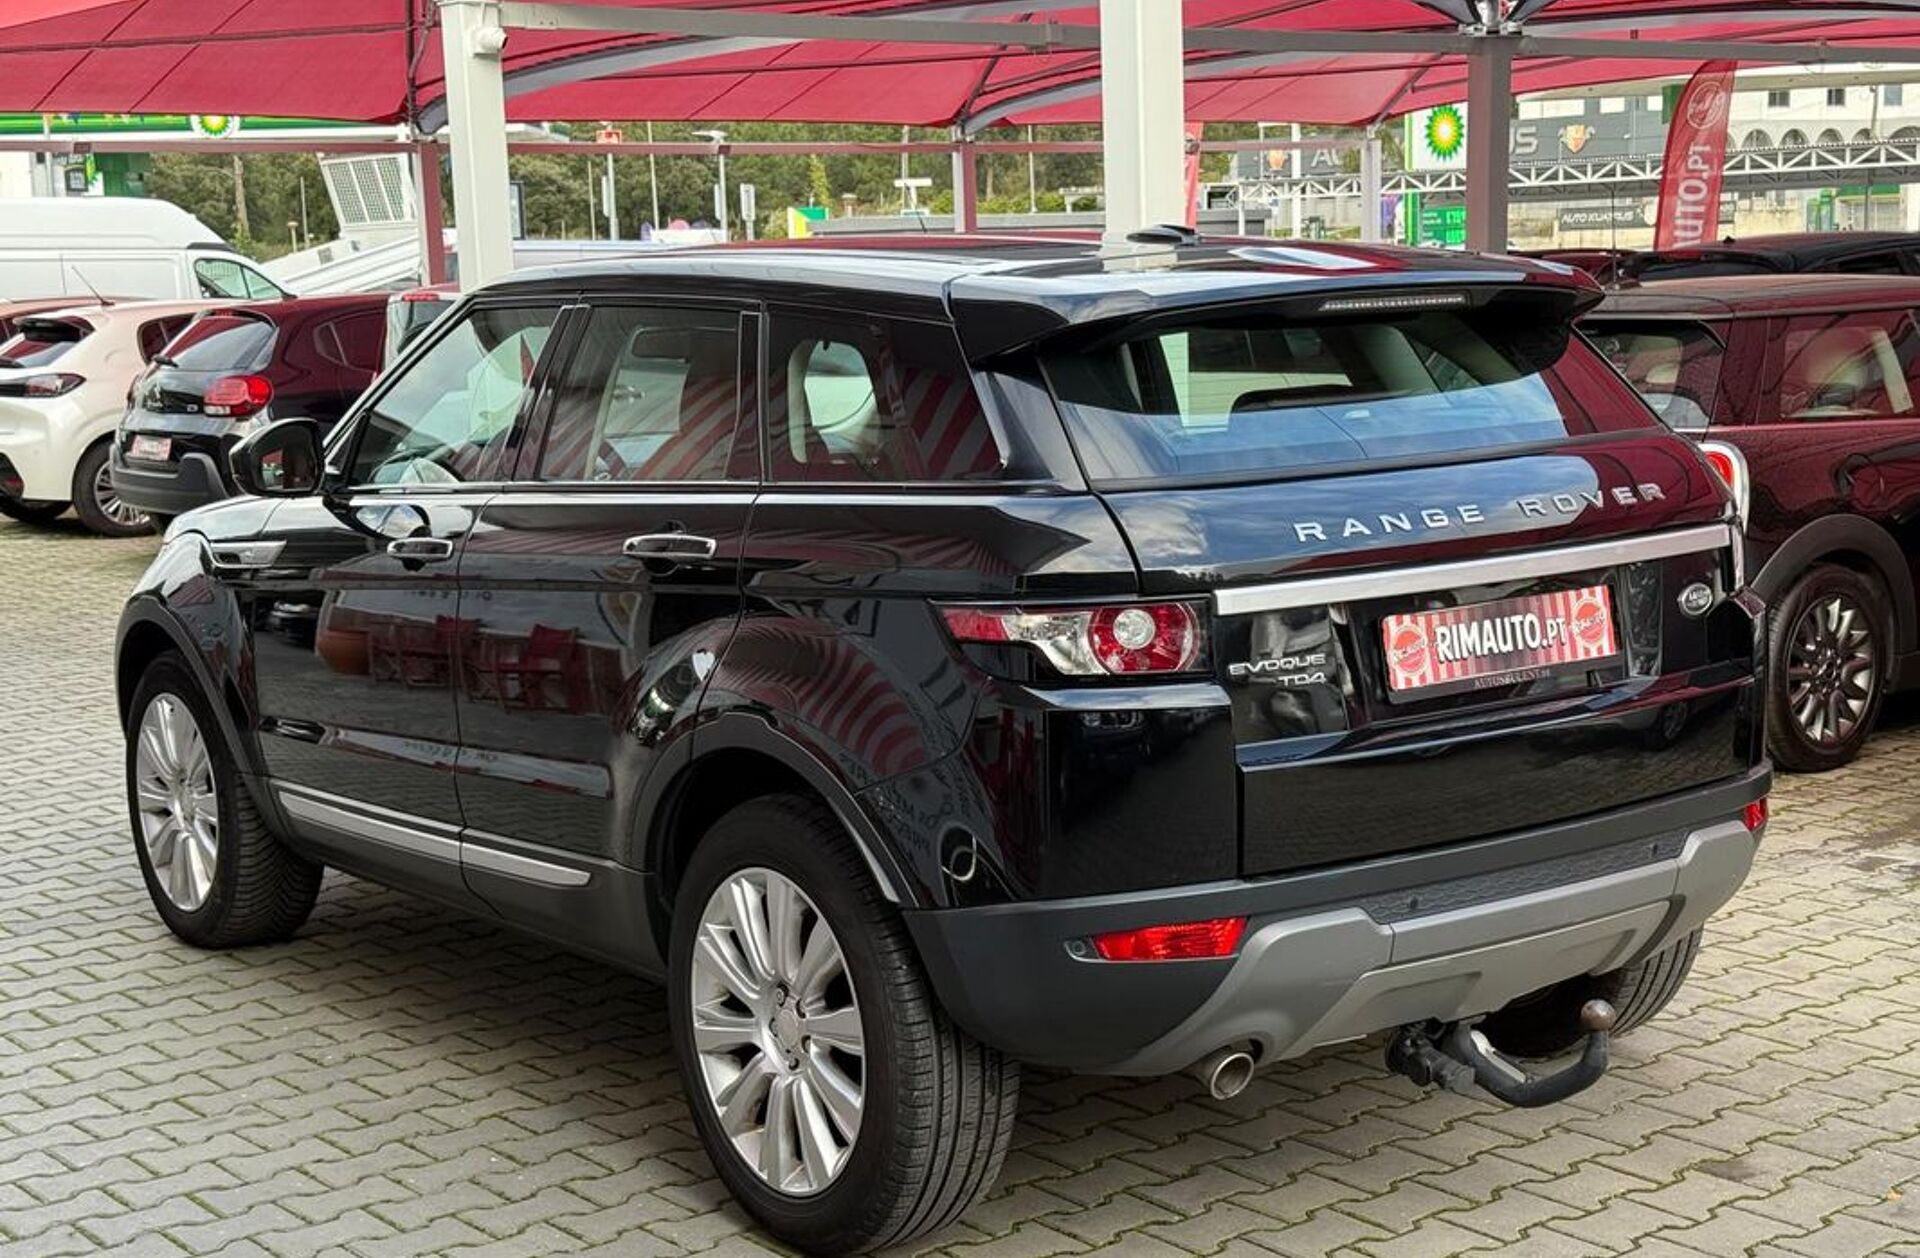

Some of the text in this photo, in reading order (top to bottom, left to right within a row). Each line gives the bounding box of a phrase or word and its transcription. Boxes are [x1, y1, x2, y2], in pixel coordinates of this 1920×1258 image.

[1292, 482, 1668, 543] RANGE ROVER
[1434, 612, 1568, 664] RIMAUTO.PT
[1228, 652, 1327, 676] EVOQUE
[1277, 671, 1327, 687] TD4
